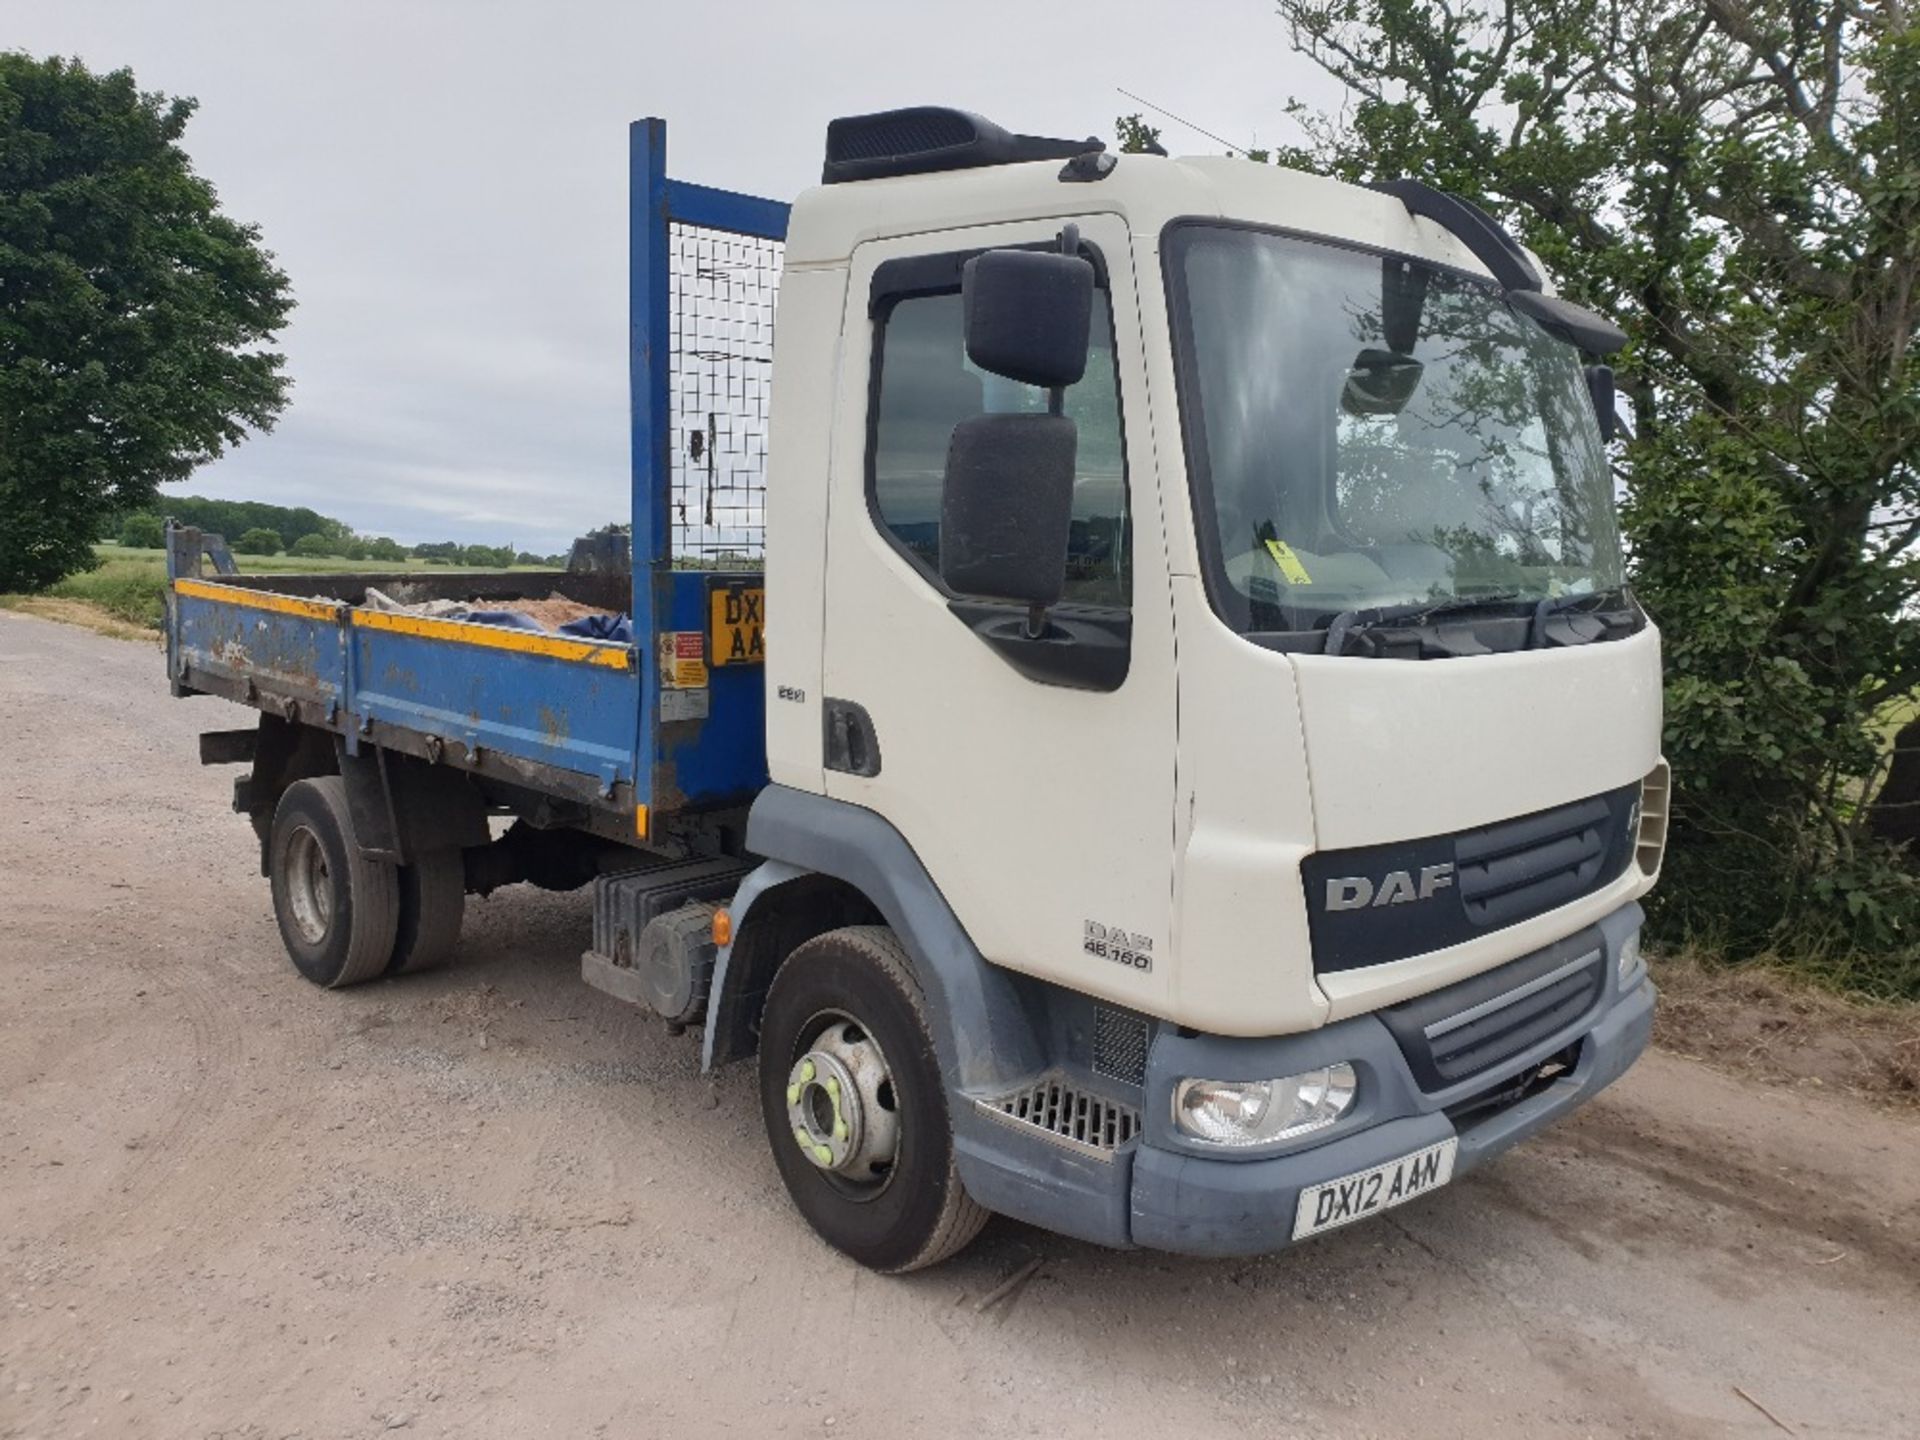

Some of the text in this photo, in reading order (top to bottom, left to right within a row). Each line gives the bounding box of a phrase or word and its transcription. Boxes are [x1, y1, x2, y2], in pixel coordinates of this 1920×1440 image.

[731, 627, 765, 657] AA
[1325, 861, 1455, 911] DAF
[1313, 1150, 1441, 1227] DX12 AAN
